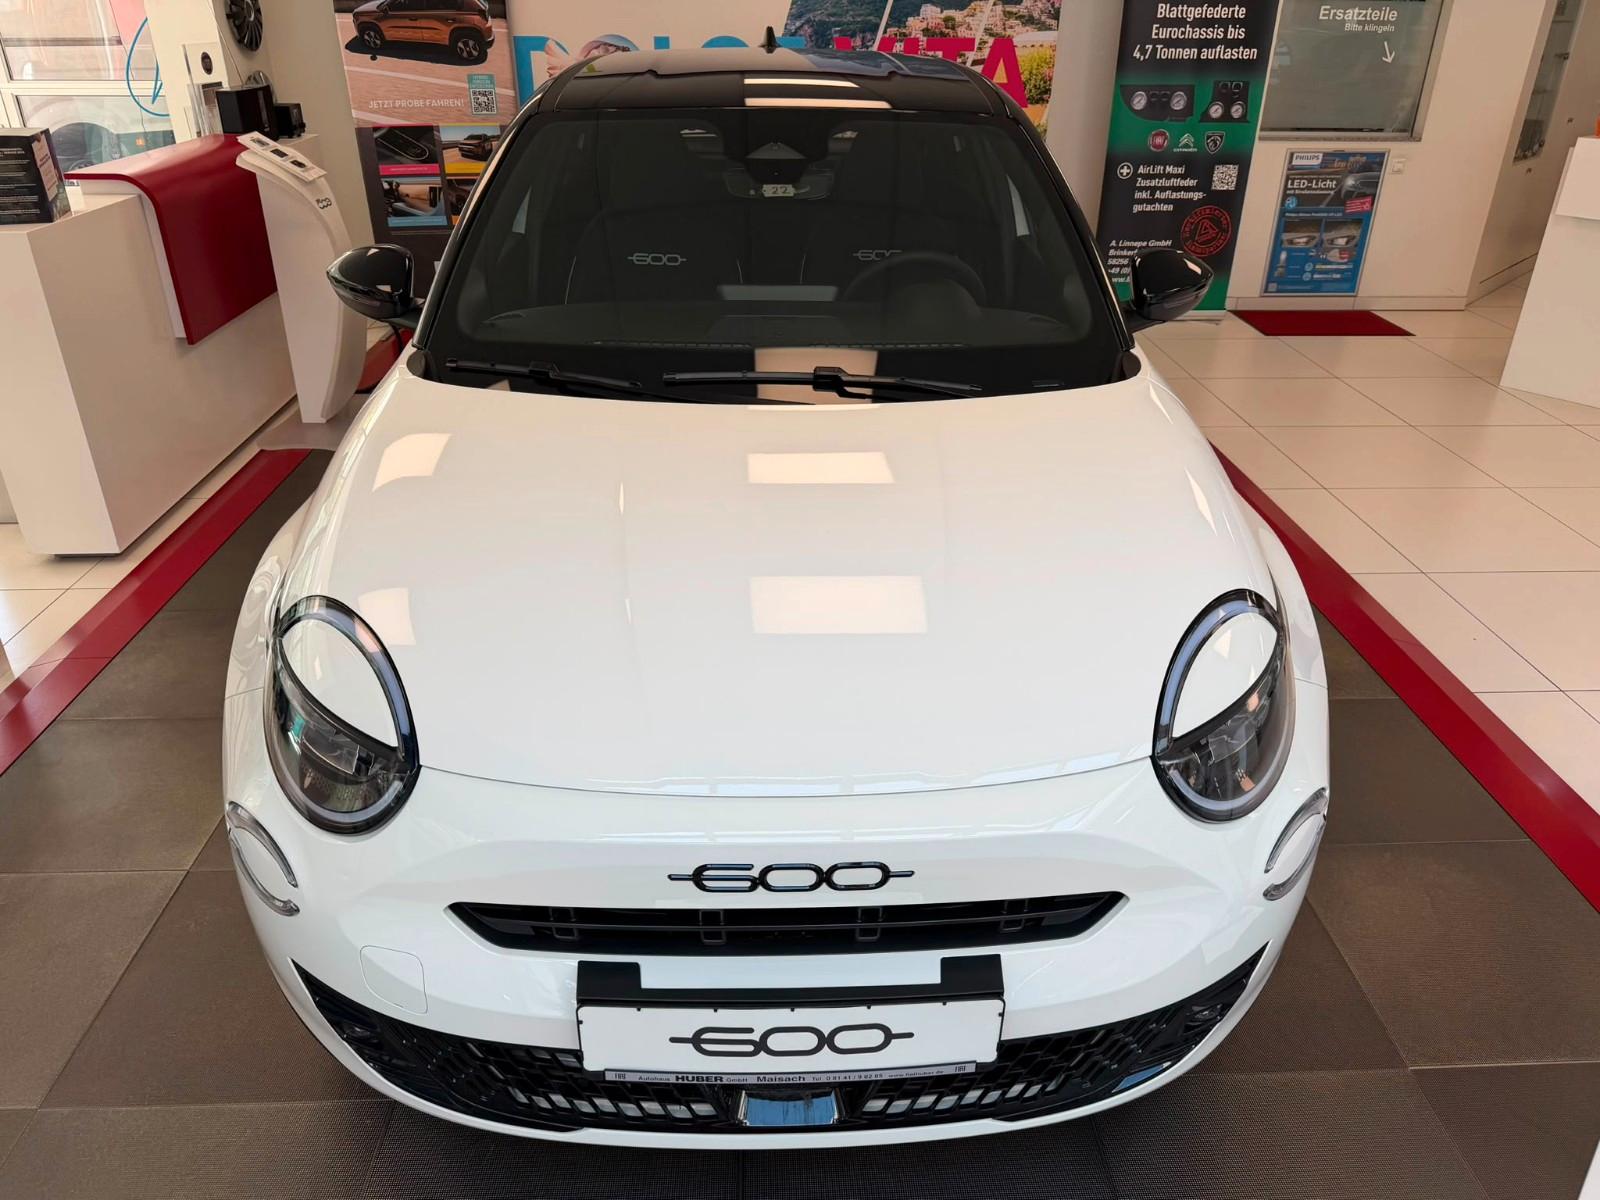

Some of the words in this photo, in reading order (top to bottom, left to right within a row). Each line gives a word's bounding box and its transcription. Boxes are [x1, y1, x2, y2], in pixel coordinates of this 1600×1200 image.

[1157, 3, 1246, 21] Blattgefederte
[1319, 5, 1398, 21] Ersatzteile
[1151, 24, 1224, 39] Eurochassis
[1227, 24, 1246, 39] bis
[1344, 23, 1363, 32] Bitte
[1364, 23, 1395, 34] klingeln
[1132, 45, 1153, 61] 4,7
[1155, 45, 1198, 60] Tonnen
[1200, 45, 1258, 60] auflasten
[368, 99, 394, 109] JETZT
[395, 99, 425, 108] PROBE
[425, 99, 465, 108] FAHREN!
[1295, 153, 1320, 161] PHILIPS
[1137, 165, 1164, 175] AirLift
[1165, 165, 1186, 175] Maxi
[1136, 178, 1198, 187] Zusatzluftfeder
[1287, 178, 1338, 189] LED-Licht
[1134, 190, 1153, 199] inkl.
[1154, 190, 1207, 200] Auflastungs-
[1132, 203, 1174, 213] gutachten
[1118, 240, 1148, 248] Linnepe
[628, 252, 686, 266] 600
[668, 861, 915, 893] 600
[668, 1022, 915, 1058] 600
[675, 1074, 724, 1083] HUBER
[756, 1075, 806, 1083] Maisach
